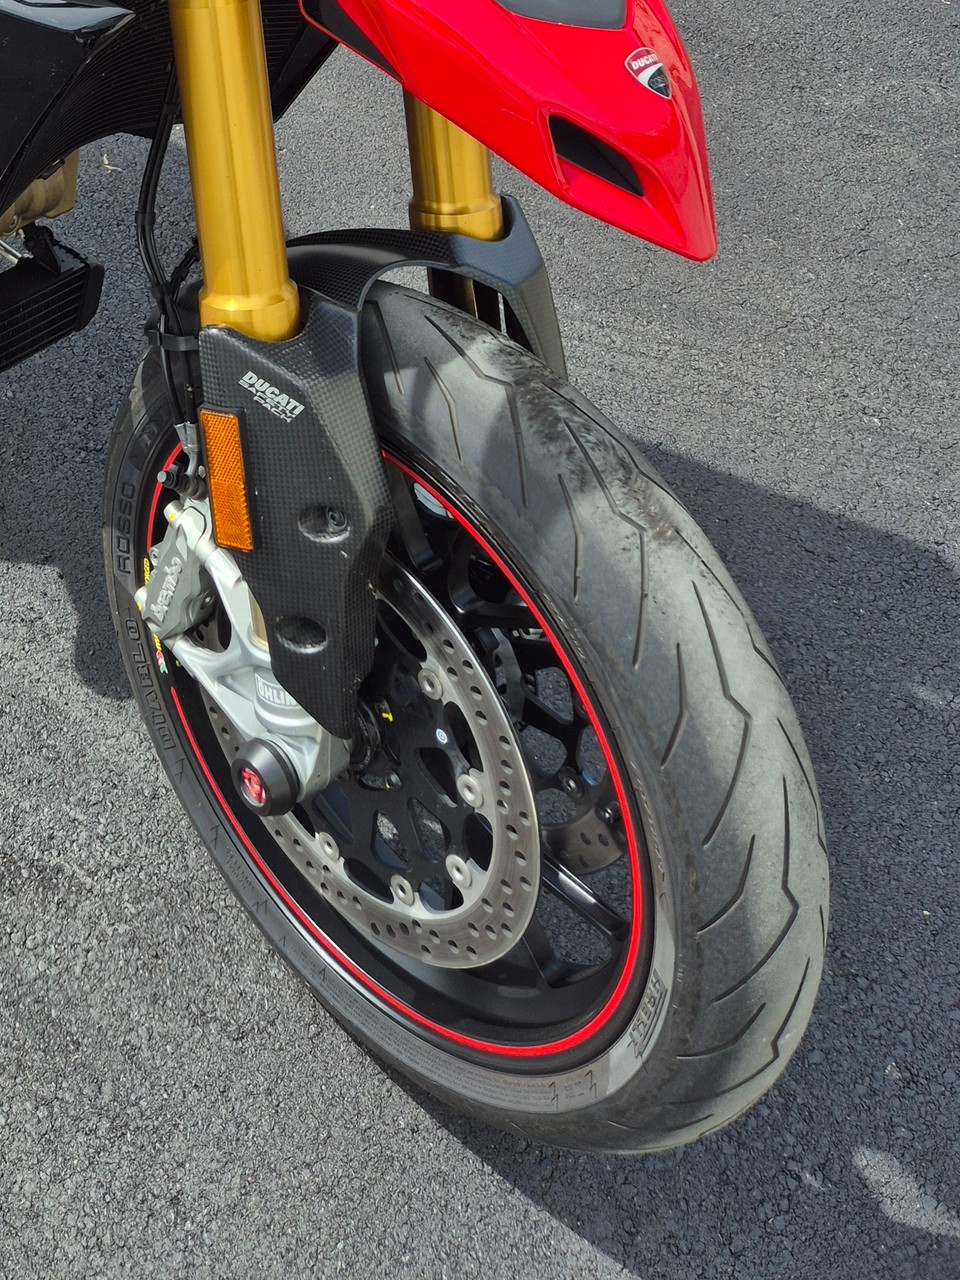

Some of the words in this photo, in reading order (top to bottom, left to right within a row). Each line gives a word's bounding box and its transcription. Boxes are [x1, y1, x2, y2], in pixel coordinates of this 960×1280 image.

[242, 371, 305, 415] DUCATI
[253, 395, 293, 423] PACK
[117, 482, 136, 574] ROSSO
[150, 557, 183, 623] brembo
[125, 617, 176, 751] DIABLO
